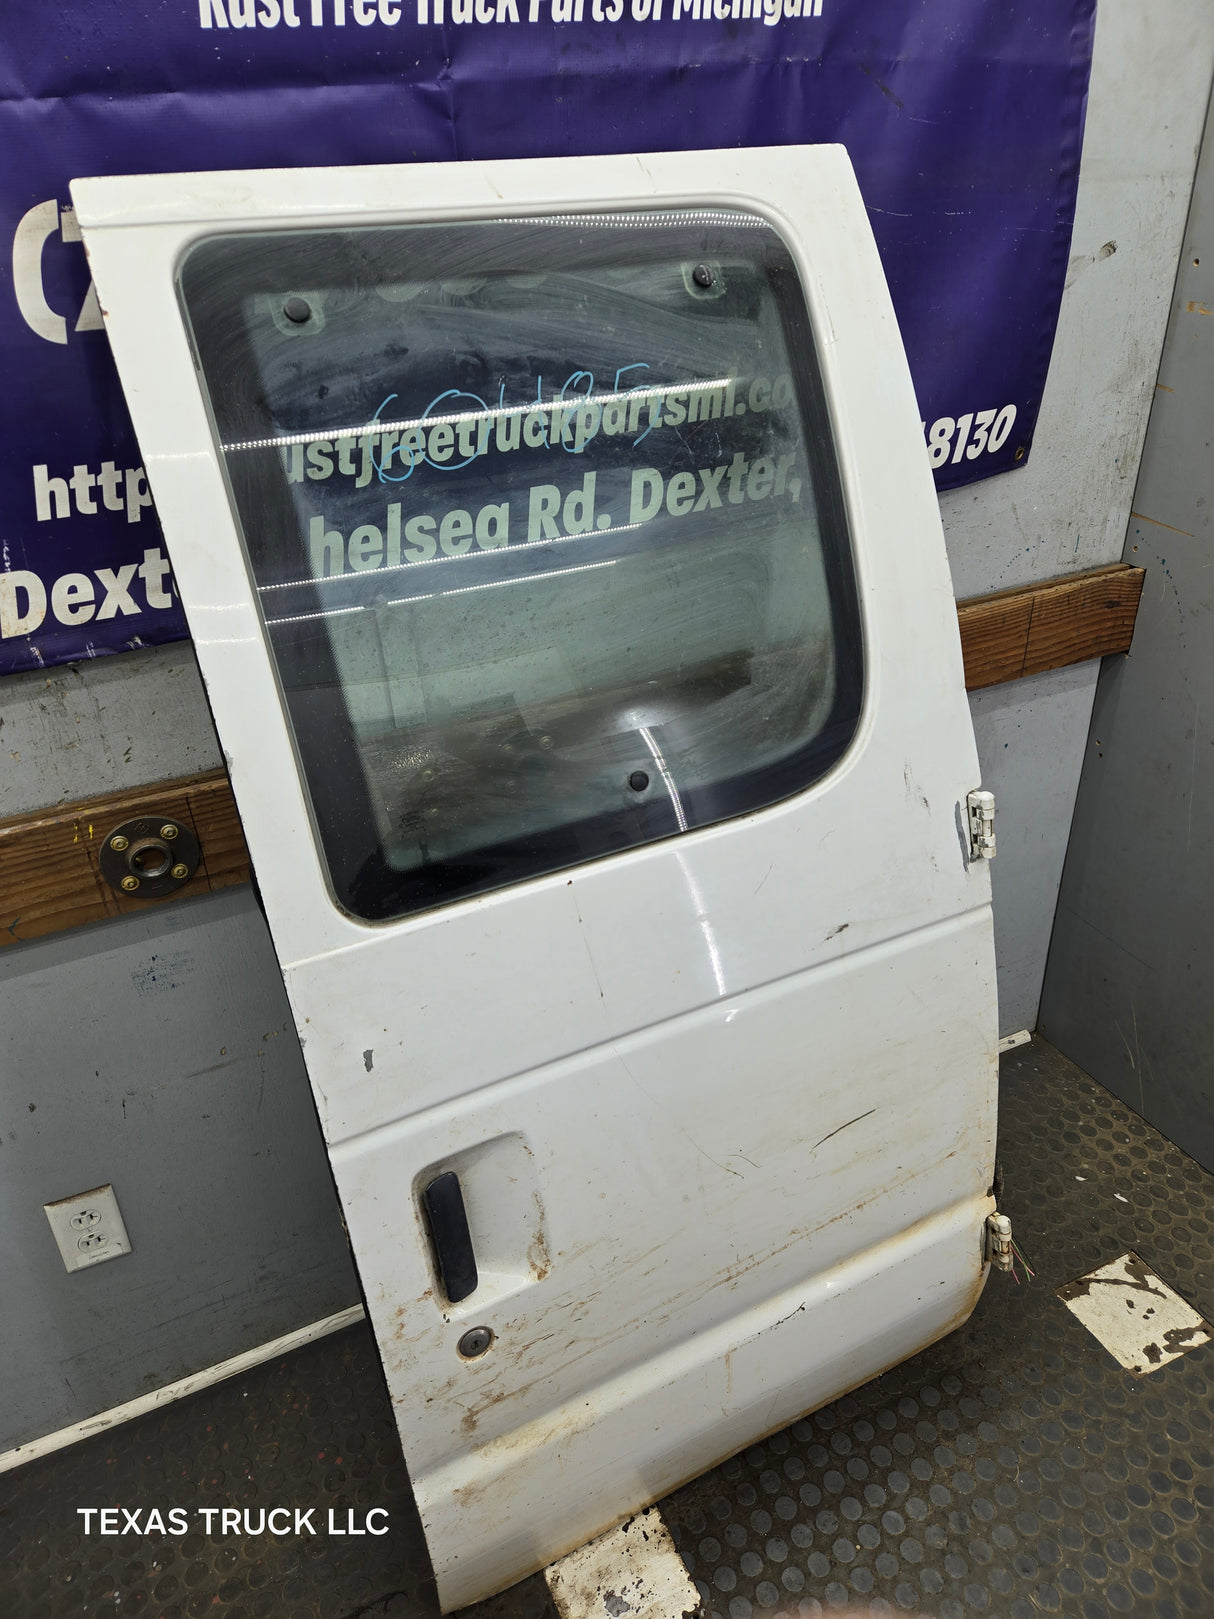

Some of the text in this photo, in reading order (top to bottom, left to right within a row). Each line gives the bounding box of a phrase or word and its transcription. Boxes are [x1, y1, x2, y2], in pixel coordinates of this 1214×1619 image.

[0, 547, 181, 638] Dext
[527, 470, 612, 542] Rd.
[629, 452, 802, 523] Dexter,
[922, 404, 1017, 469] 8130
